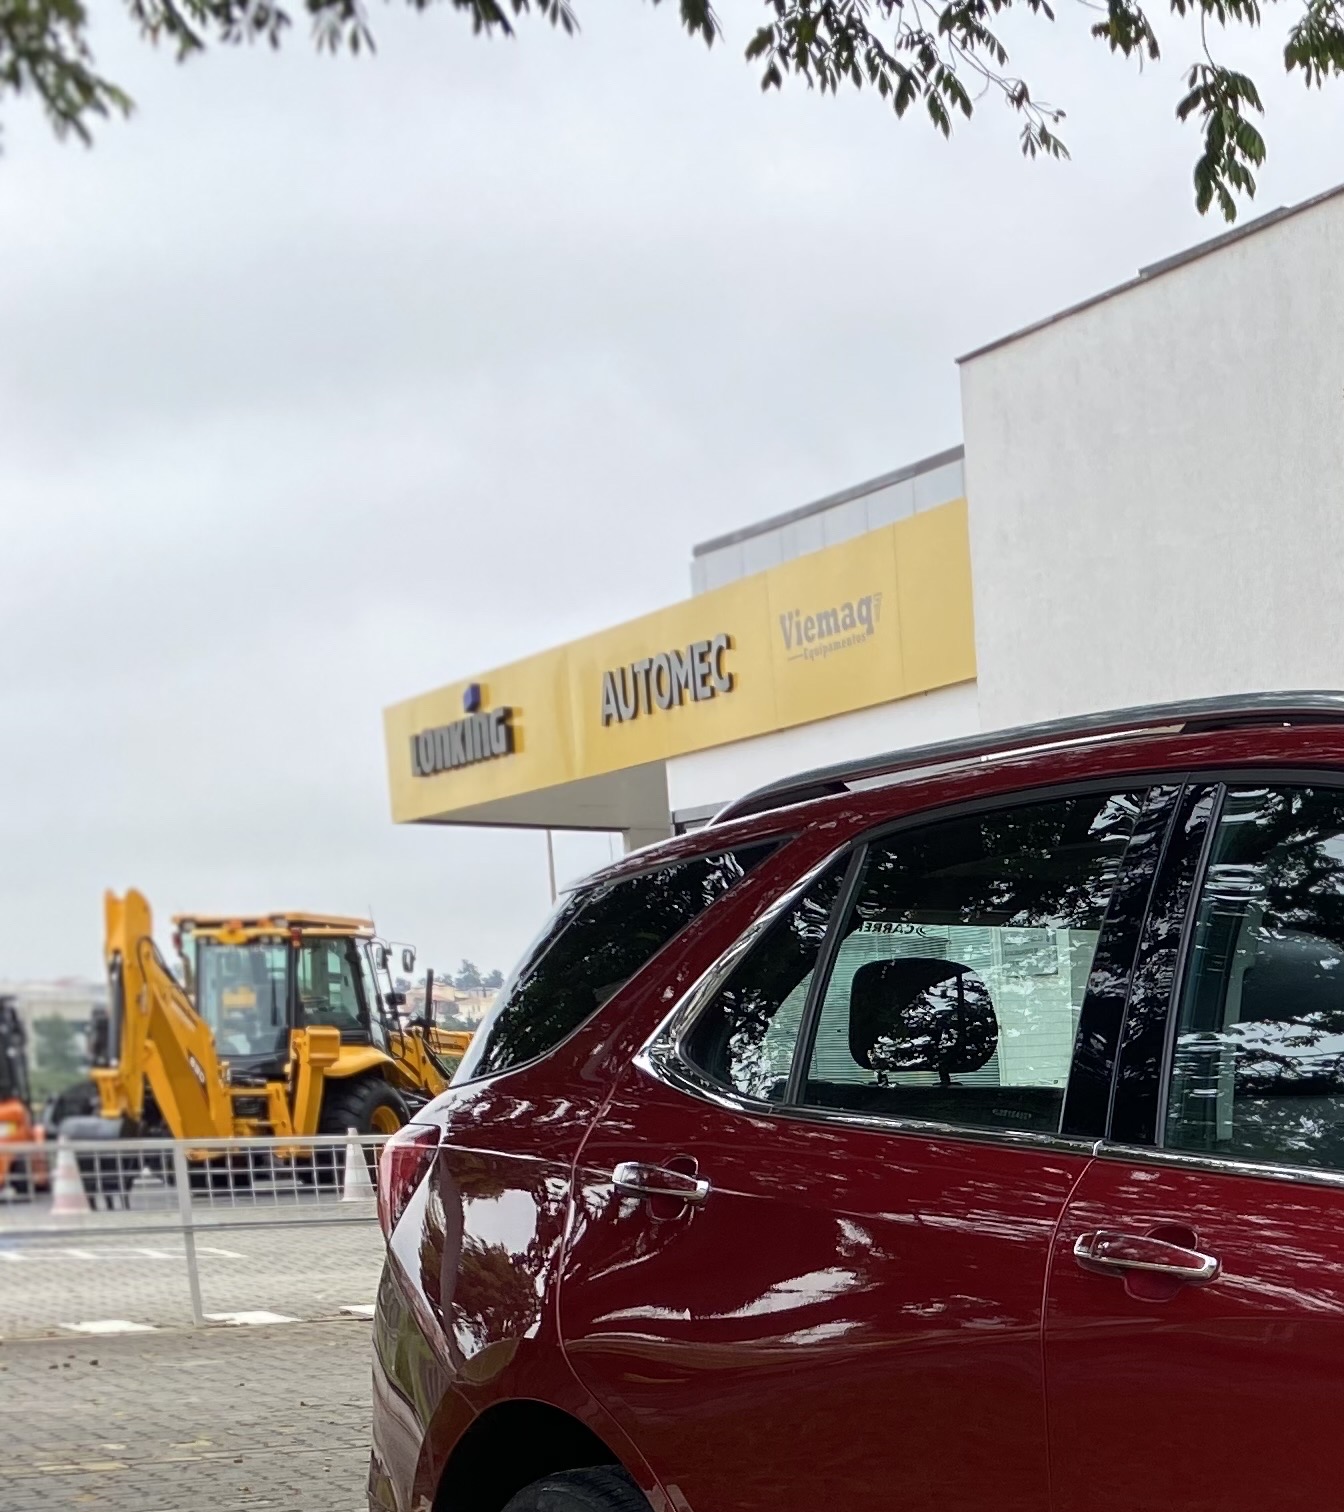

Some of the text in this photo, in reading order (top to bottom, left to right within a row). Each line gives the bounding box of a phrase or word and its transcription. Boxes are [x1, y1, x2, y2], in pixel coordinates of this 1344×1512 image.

[779, 594, 875, 651] Viemaq
[803, 632, 867, 662] Equipamentos
[601, 633, 733, 728] AUTOMEC
